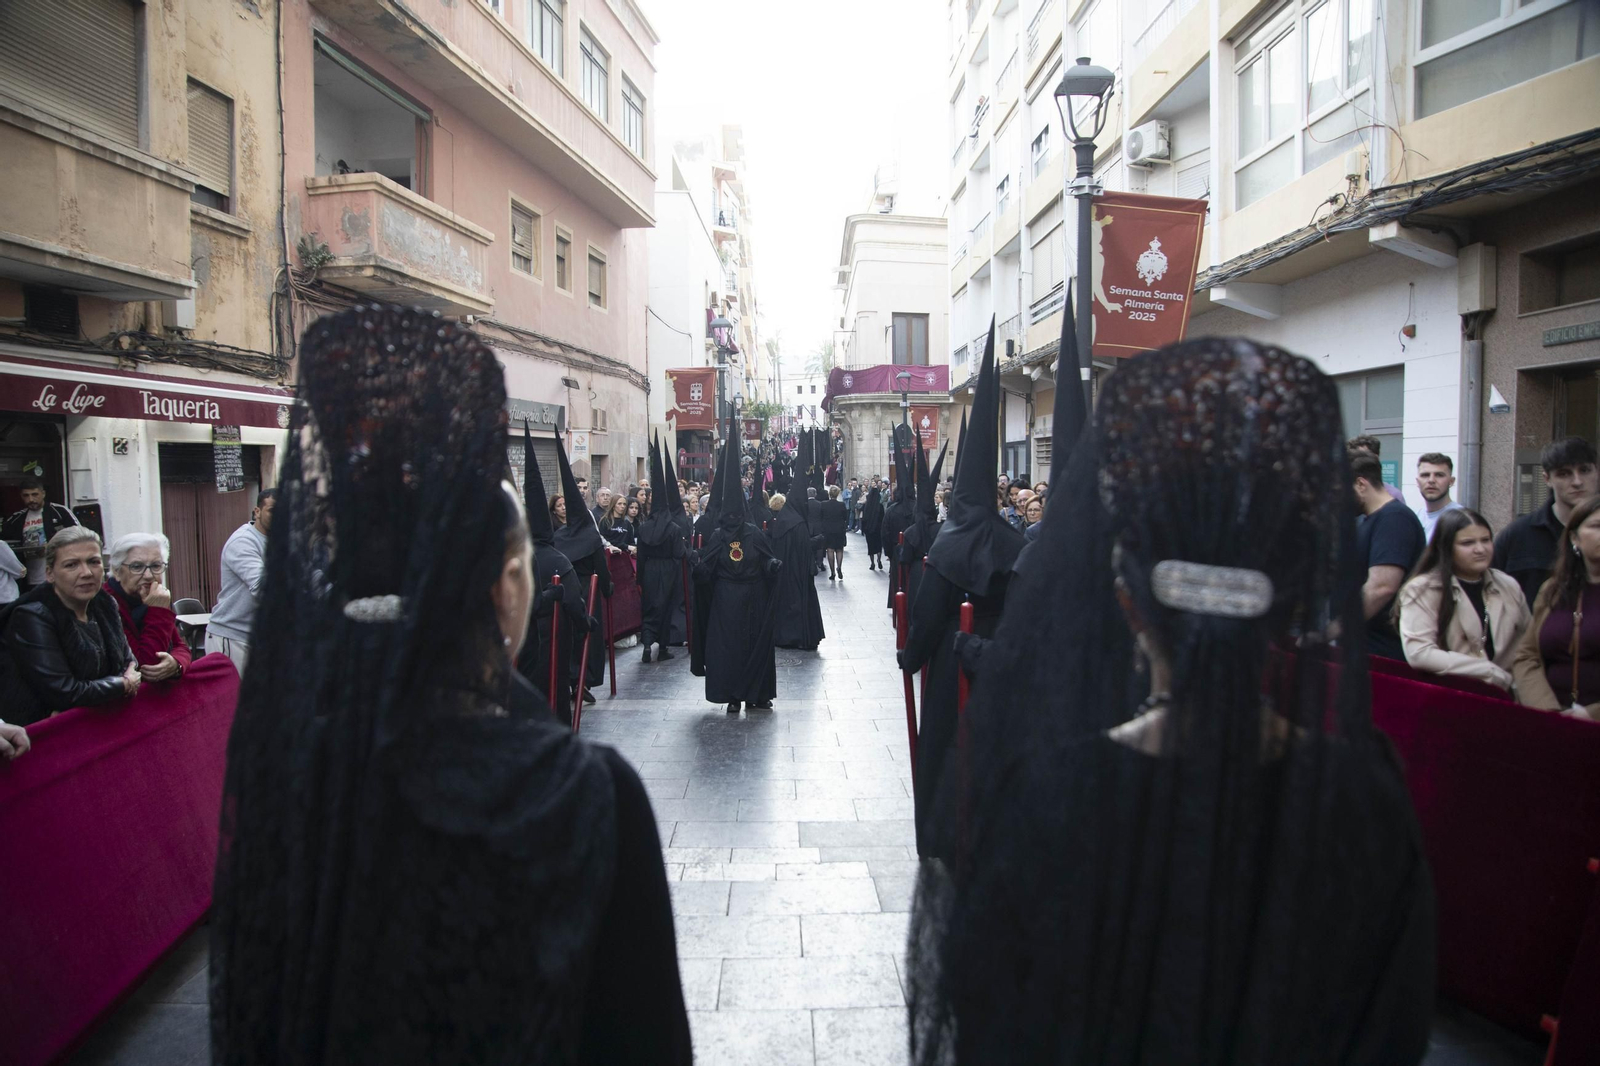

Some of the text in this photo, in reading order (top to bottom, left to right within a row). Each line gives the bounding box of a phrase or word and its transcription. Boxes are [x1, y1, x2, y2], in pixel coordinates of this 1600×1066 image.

[1109, 285, 1184, 301] Semana Santa
[1124, 299, 1165, 311] Almería
[1128, 311, 1157, 322] 2025
[1545, 328, 1577, 343] EDIFICIO
[32, 383, 221, 421] La Lupe Taquería
[114, 438, 128, 455] 23
